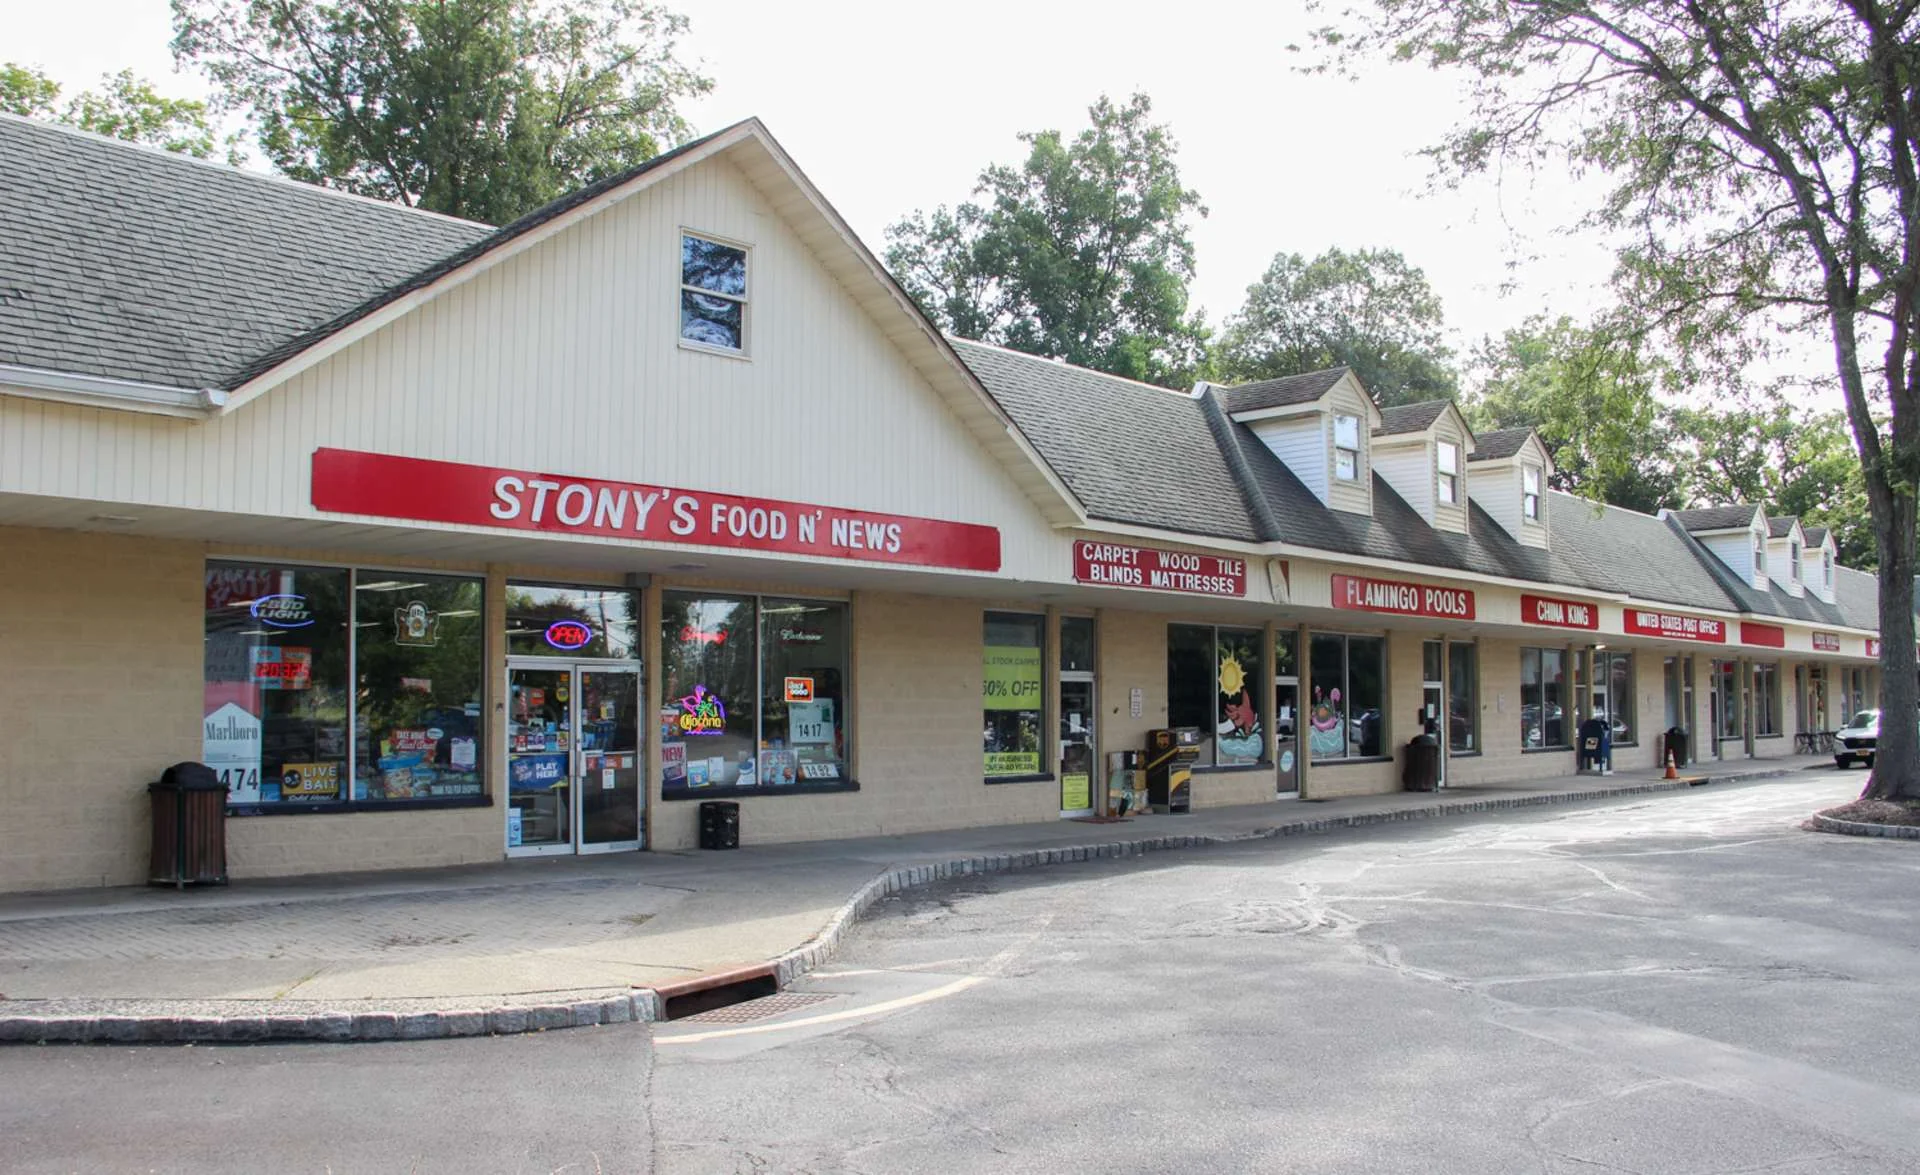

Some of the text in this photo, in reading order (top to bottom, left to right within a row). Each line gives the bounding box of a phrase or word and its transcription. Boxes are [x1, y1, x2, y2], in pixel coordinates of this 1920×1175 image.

[490, 475, 901, 554] STONY'S FOOD N' NEWS
[1082, 543, 1242, 576] CARPET WOOD TILE
[1090, 563, 1235, 594] BLINDS MATTRESSES
[266, 600, 305, 610] BUD
[1347, 579, 1466, 616] FLAMINGO POOLS
[258, 609, 311, 620] LIGHT
[1537, 599, 1589, 626] CHINA KING
[1636, 612, 1659, 628] UNITED
[1660, 615, 1682, 631] STATES
[1683, 618, 1697, 632] POST
[1699, 620, 1719, 635] OFFICE
[551, 626, 586, 644] OPEN
[992, 656, 1014, 665] STOCK
[1011, 680, 1039, 696] OFF
[205, 715, 258, 741] Marlboro
[303, 766, 337, 778] LIVE
[535, 761, 557, 771] PLAY
[535, 770, 559, 780] HERE
[303, 779, 336, 791] BAIT
